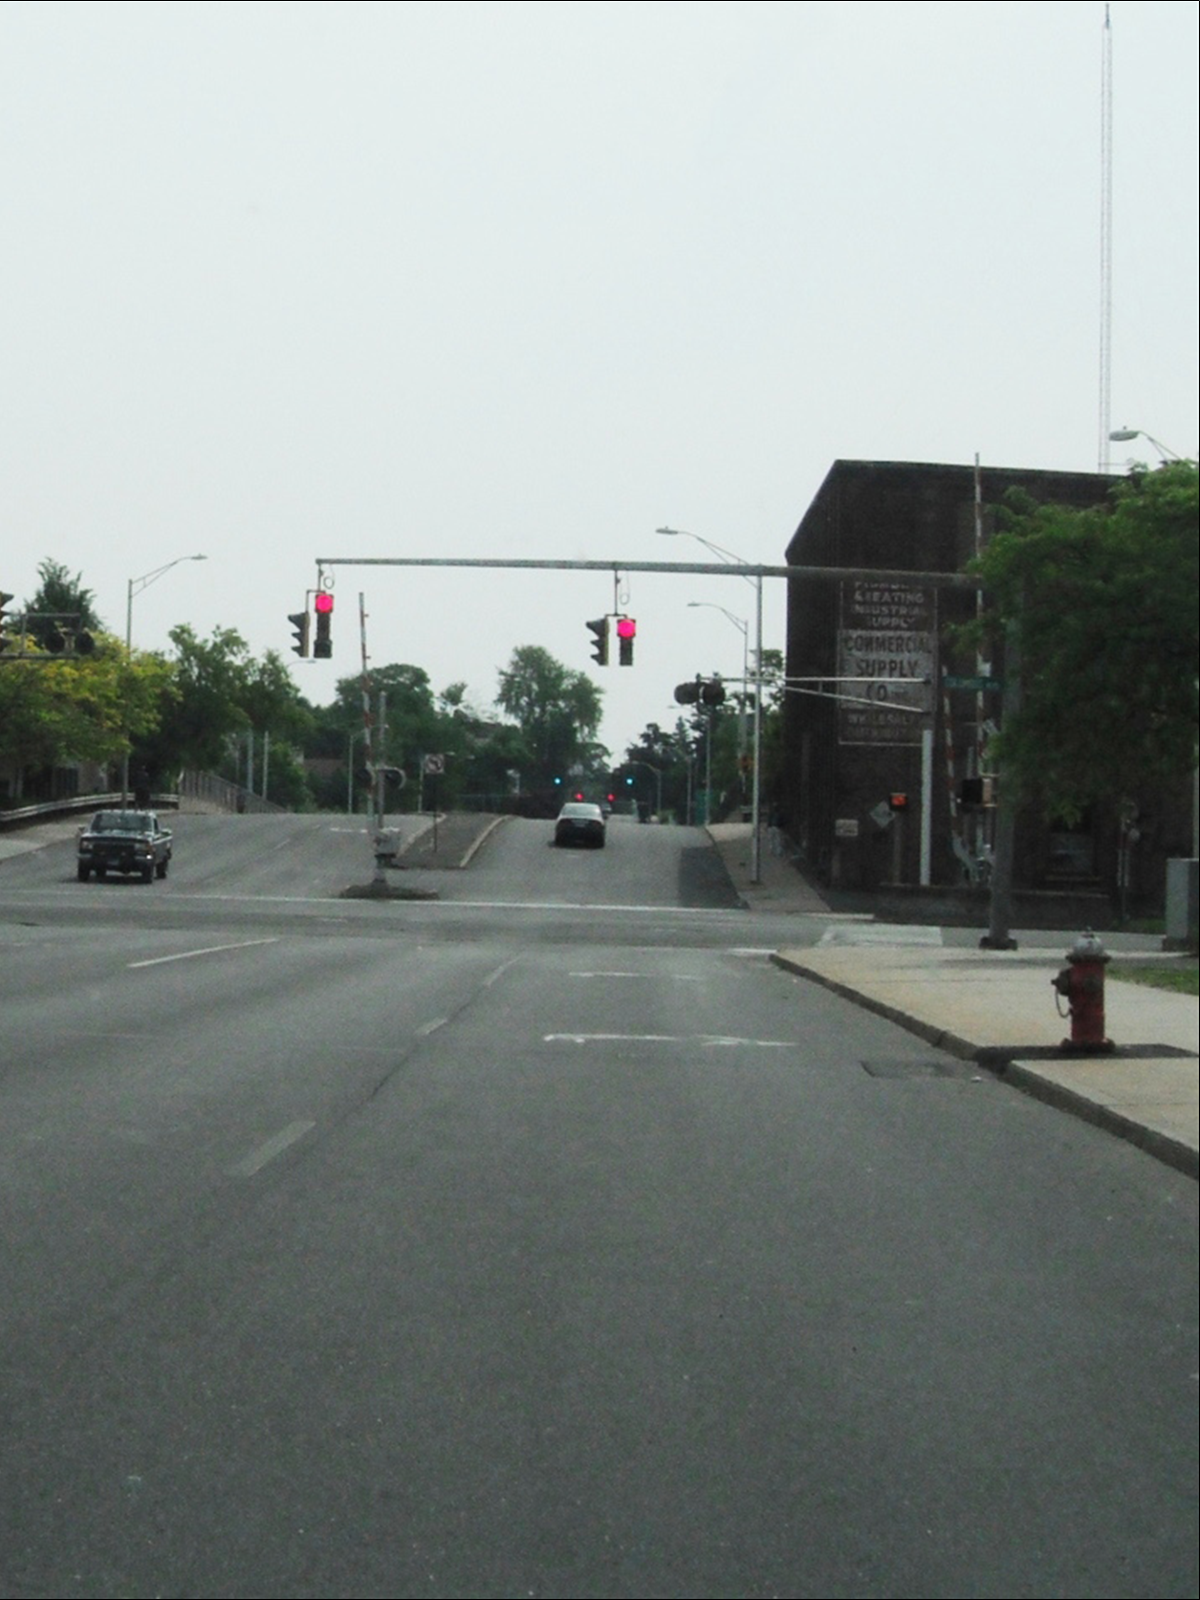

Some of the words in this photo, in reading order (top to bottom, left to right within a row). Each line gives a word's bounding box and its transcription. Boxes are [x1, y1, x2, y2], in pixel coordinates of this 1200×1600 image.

[850, 603, 927, 615] NUSTRIA
[866, 616, 915, 628] UPPLY
[845, 635, 932, 654] COMMERCIAL
[856, 659, 919, 678] SUPPLY
